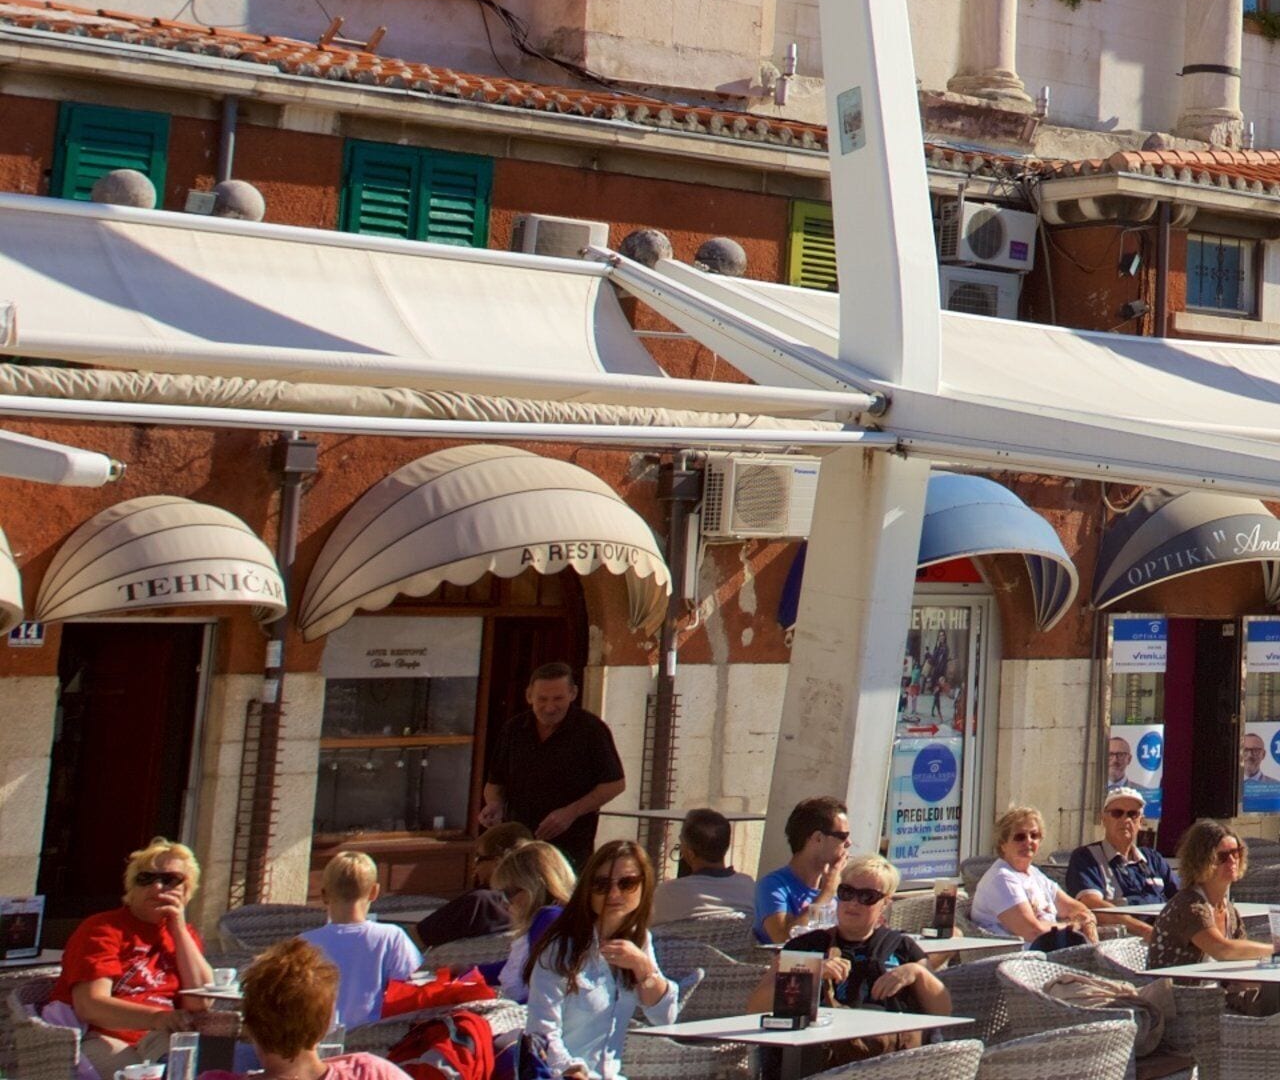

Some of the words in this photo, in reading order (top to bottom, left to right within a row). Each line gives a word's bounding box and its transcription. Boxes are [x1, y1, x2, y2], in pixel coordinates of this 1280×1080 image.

[521, 548, 541, 565] A.
[1128, 545, 1216, 585] OPTIKA
[118, 570, 284, 602] TEHNIČAR
[19, 623, 38, 639] 14
[1141, 744, 1161, 759] 1+1
[896, 807, 943, 823] PREGLEDI
[896, 825, 932, 835] svakim
[895, 845, 920, 859] ULAZ
